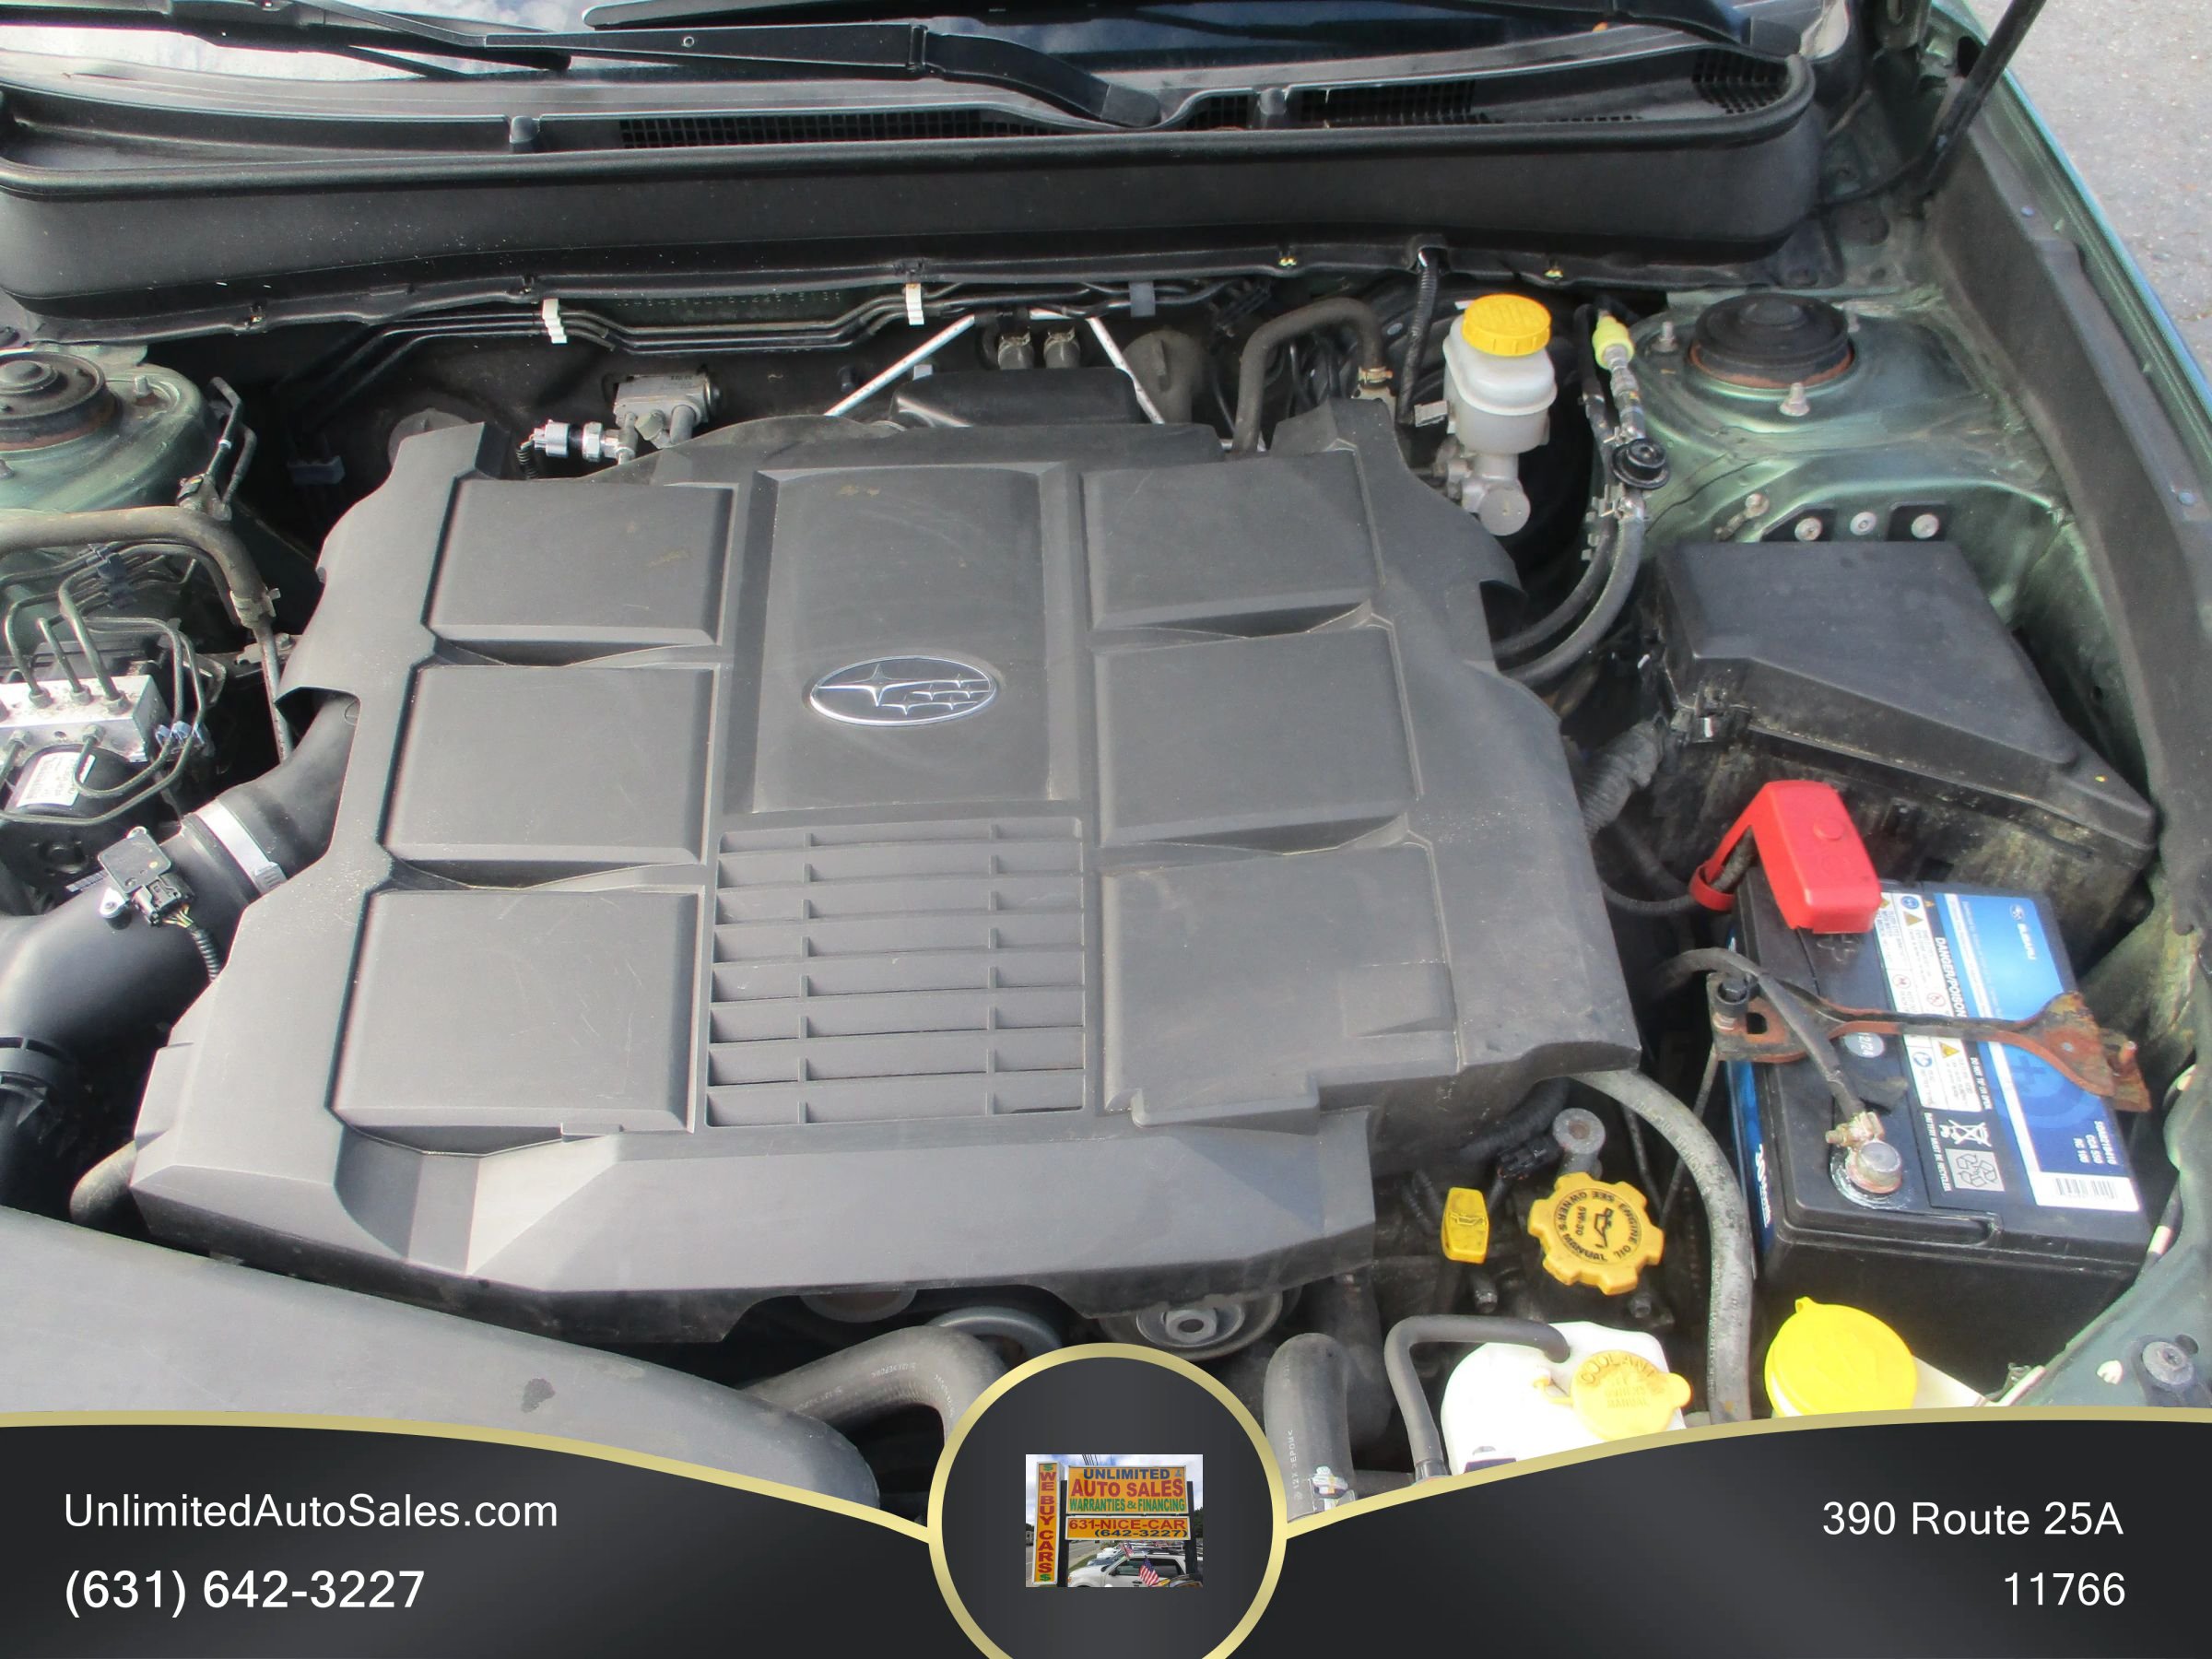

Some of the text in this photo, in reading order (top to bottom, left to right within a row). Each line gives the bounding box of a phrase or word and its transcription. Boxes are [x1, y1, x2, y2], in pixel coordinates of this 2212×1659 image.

[2017, 923, 2037, 960] SUBARU
[1935, 936, 1968, 1018] DANGER/POISON
[1924, 1112, 1937, 1137] BATTERY
[1930, 1137, 1942, 1154] MUST
[2073, 1137, 2090, 1164] RC 100
[2085, 1134, 2104, 1165] CCA 550
[1558, 1191, 1615, 1262] SEE OWNER'S MANUAL
[1575, 1206, 1586, 1236] 5W-30
[1613, 1203, 1638, 1259] ENGINE OIL
[1580, 1353, 1655, 1386] COOLANT
